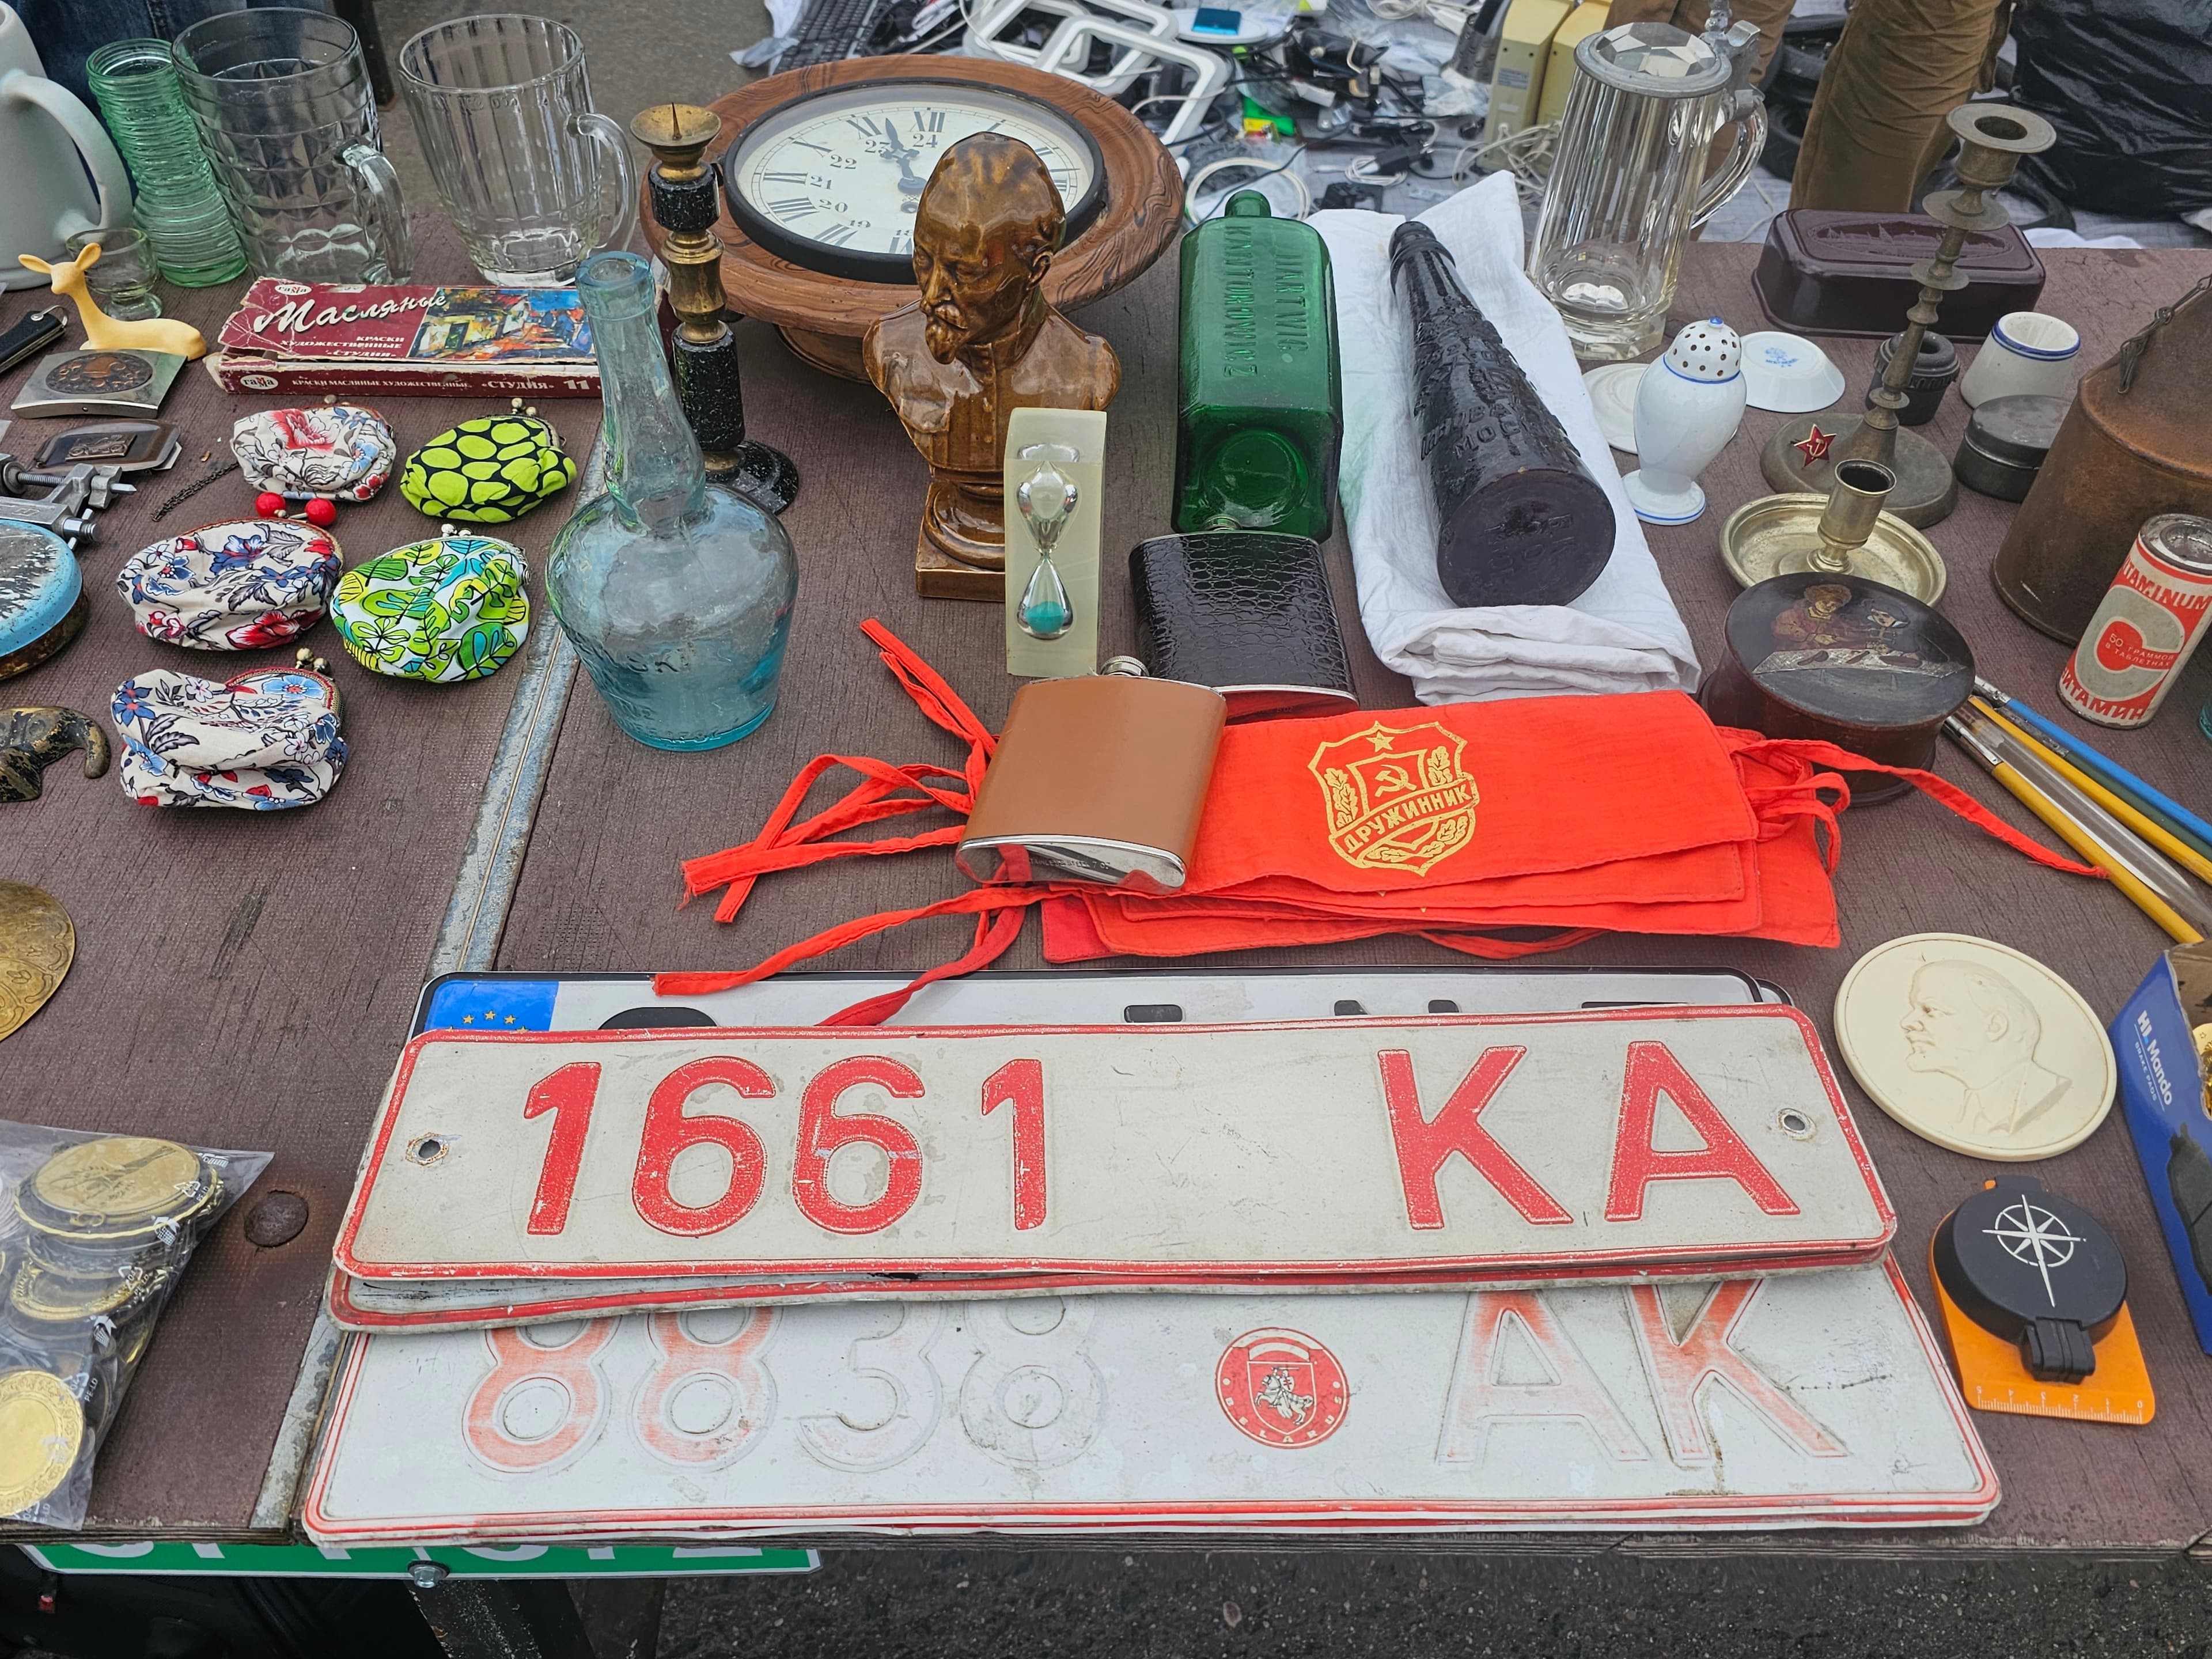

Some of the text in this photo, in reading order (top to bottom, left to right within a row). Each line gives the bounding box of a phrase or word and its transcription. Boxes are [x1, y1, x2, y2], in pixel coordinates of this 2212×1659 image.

[864, 139, 893, 154] 23
[912, 134, 938, 148] 24
[830, 154, 857, 169] 22
[810, 175, 832, 190] 21
[819, 198, 848, 213] 20
[849, 220, 872, 228] 19
[1223, 226, 1258, 378] KANTOROWICZ
[253, 294, 447, 333] Масляные
[563, 379, 590, 390] 11
[2109, 632, 2175, 661] 50 ГРАММОВ
[1343, 785, 1473, 853] ДРУЖИННИК
[2135, 1041, 2148, 1074] BRAKE
[2146, 1038, 2172, 1105] Mando
[523, 1040, 1802, 1237] 1661 KA
